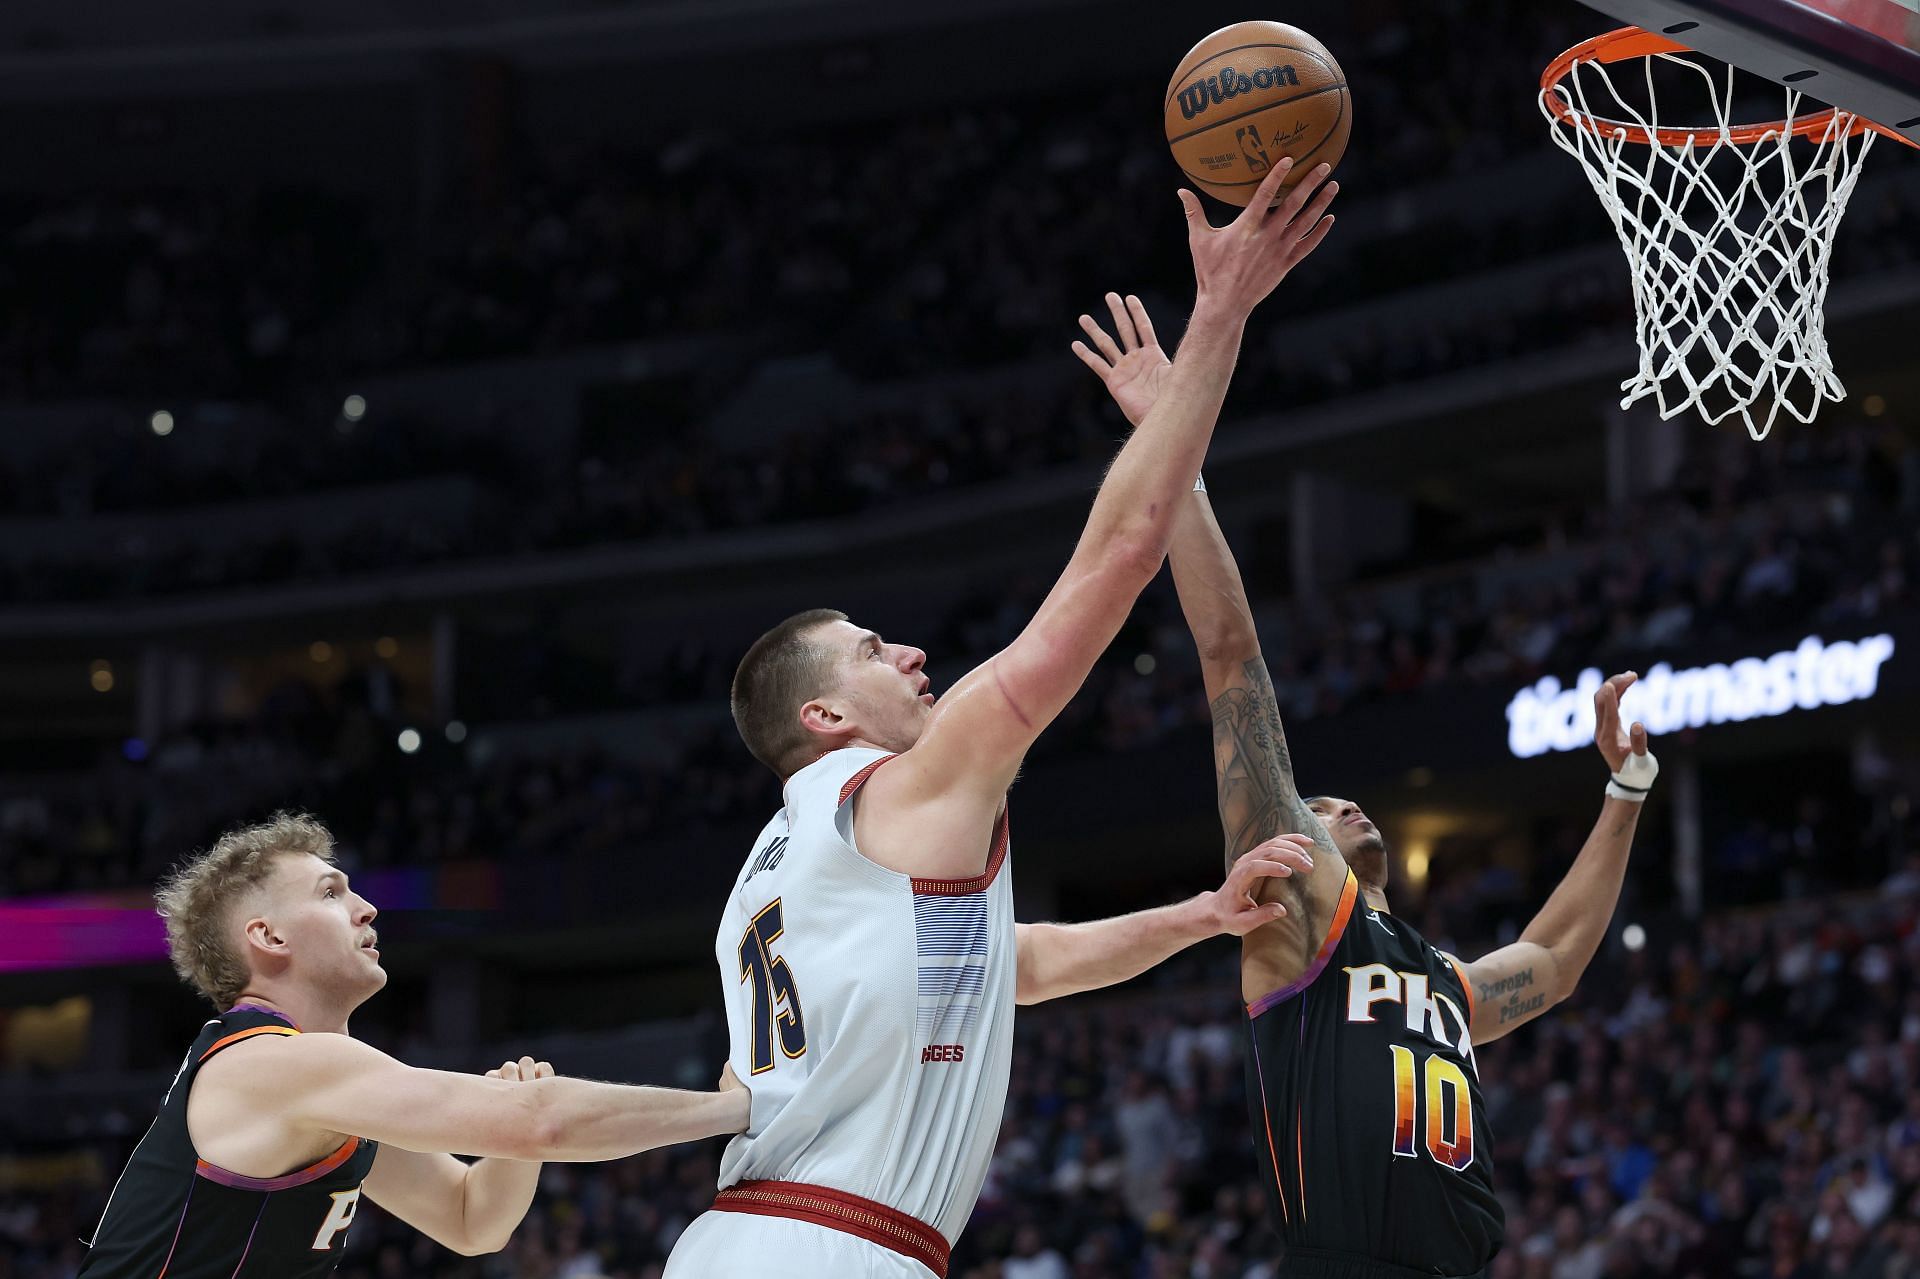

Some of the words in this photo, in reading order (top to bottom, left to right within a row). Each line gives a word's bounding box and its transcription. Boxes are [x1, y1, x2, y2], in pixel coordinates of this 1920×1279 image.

[1177, 64, 1300, 120] Wilson
[738, 896, 806, 1076] 15
[1389, 1044, 1474, 1172] 10
